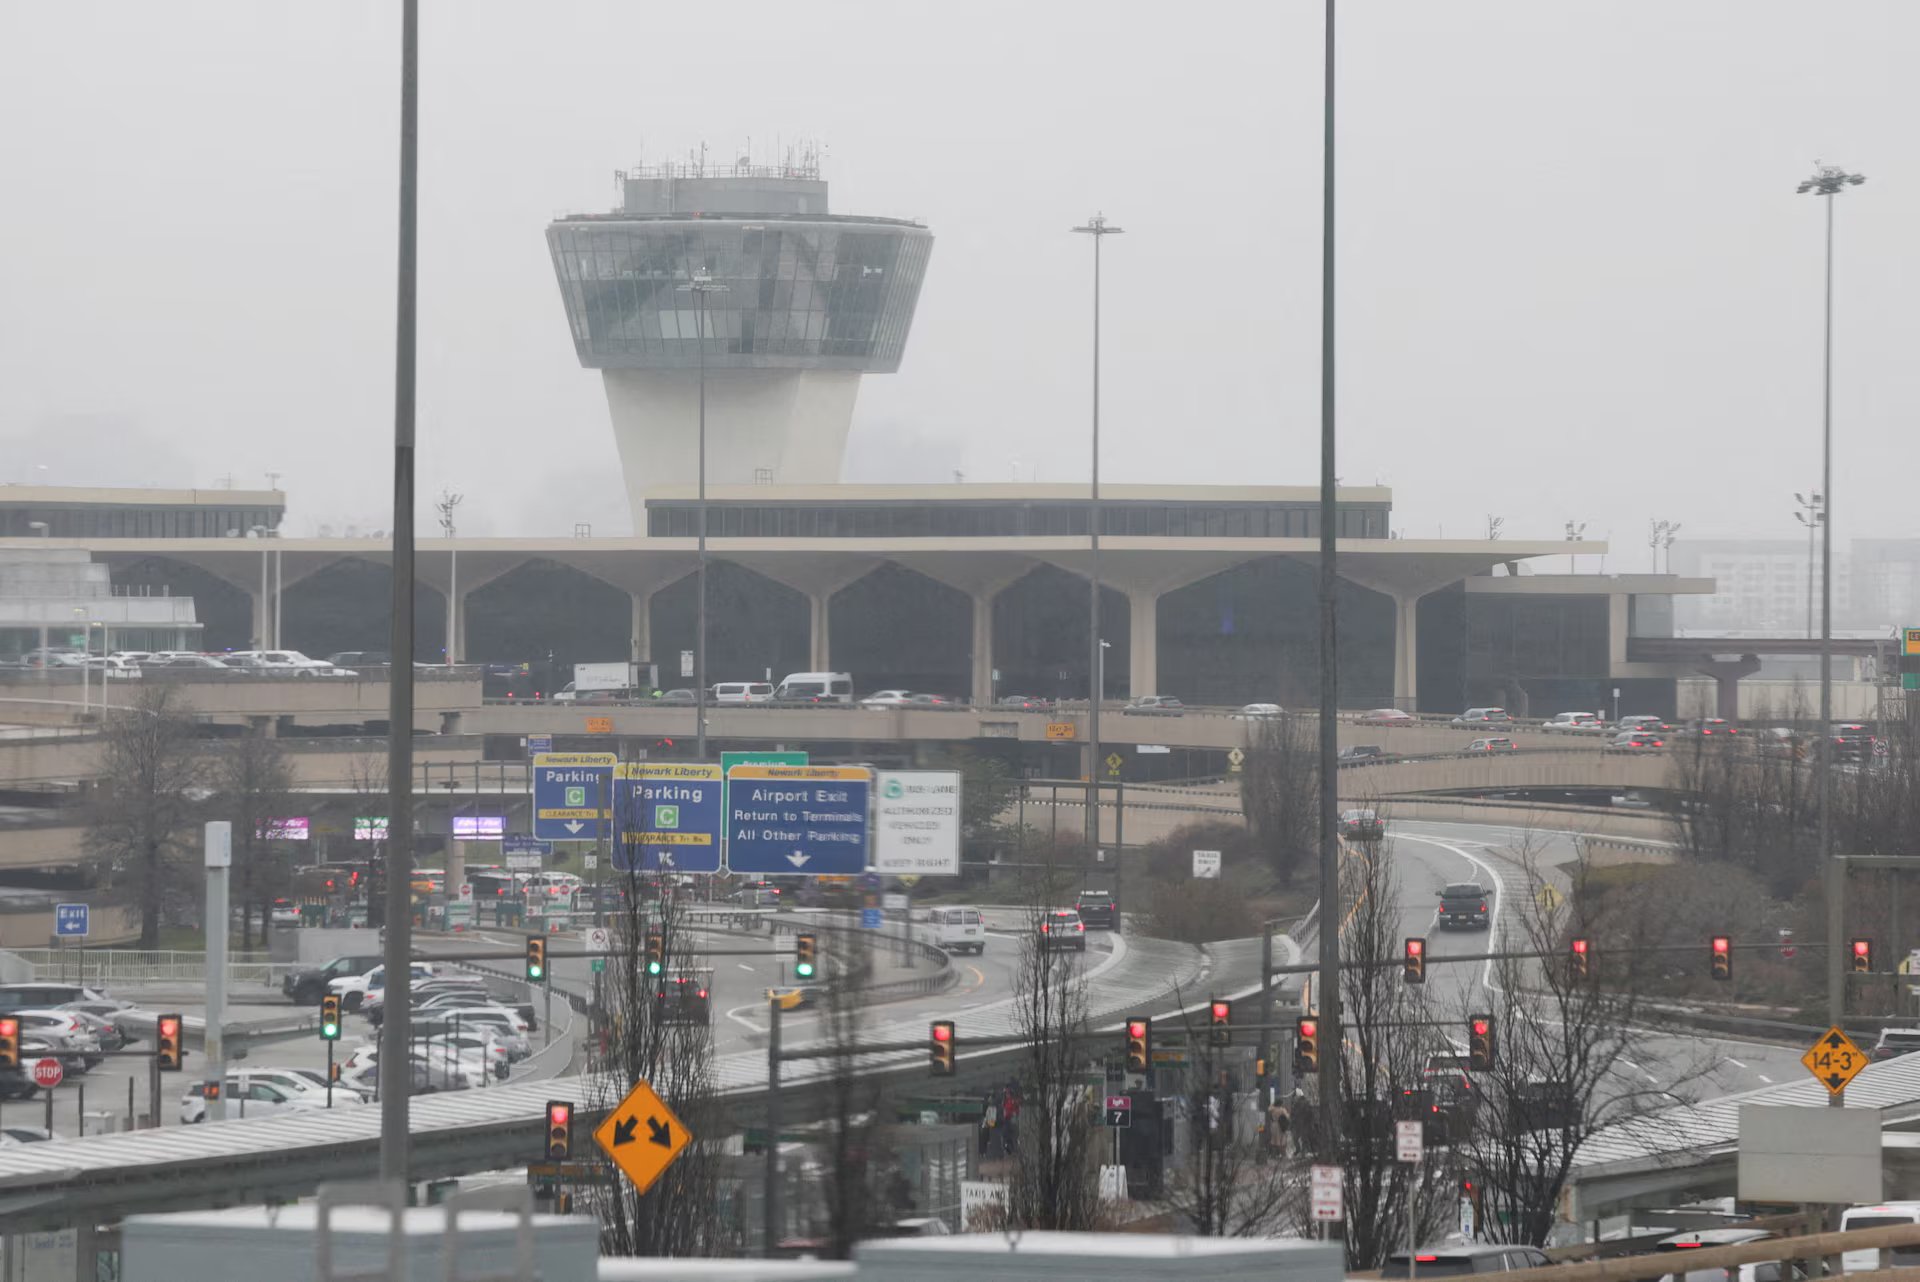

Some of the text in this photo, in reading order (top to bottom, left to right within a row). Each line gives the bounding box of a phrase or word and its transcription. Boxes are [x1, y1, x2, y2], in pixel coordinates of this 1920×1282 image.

[580, 756, 612, 765] Liberty
[674, 768, 713, 778] Liberty
[568, 789, 581, 803] C
[633, 785, 703, 804] Parking
[752, 789, 848, 804] Airport Exit
[659, 808, 673, 825] C
[734, 809, 864, 822] Return to Terminals
[737, 829, 861, 844] All Other Parking
[60, 908, 85, 919] Exit
[36, 1066, 61, 1079] STOP
[1113, 1111, 1122, 1124] 7
